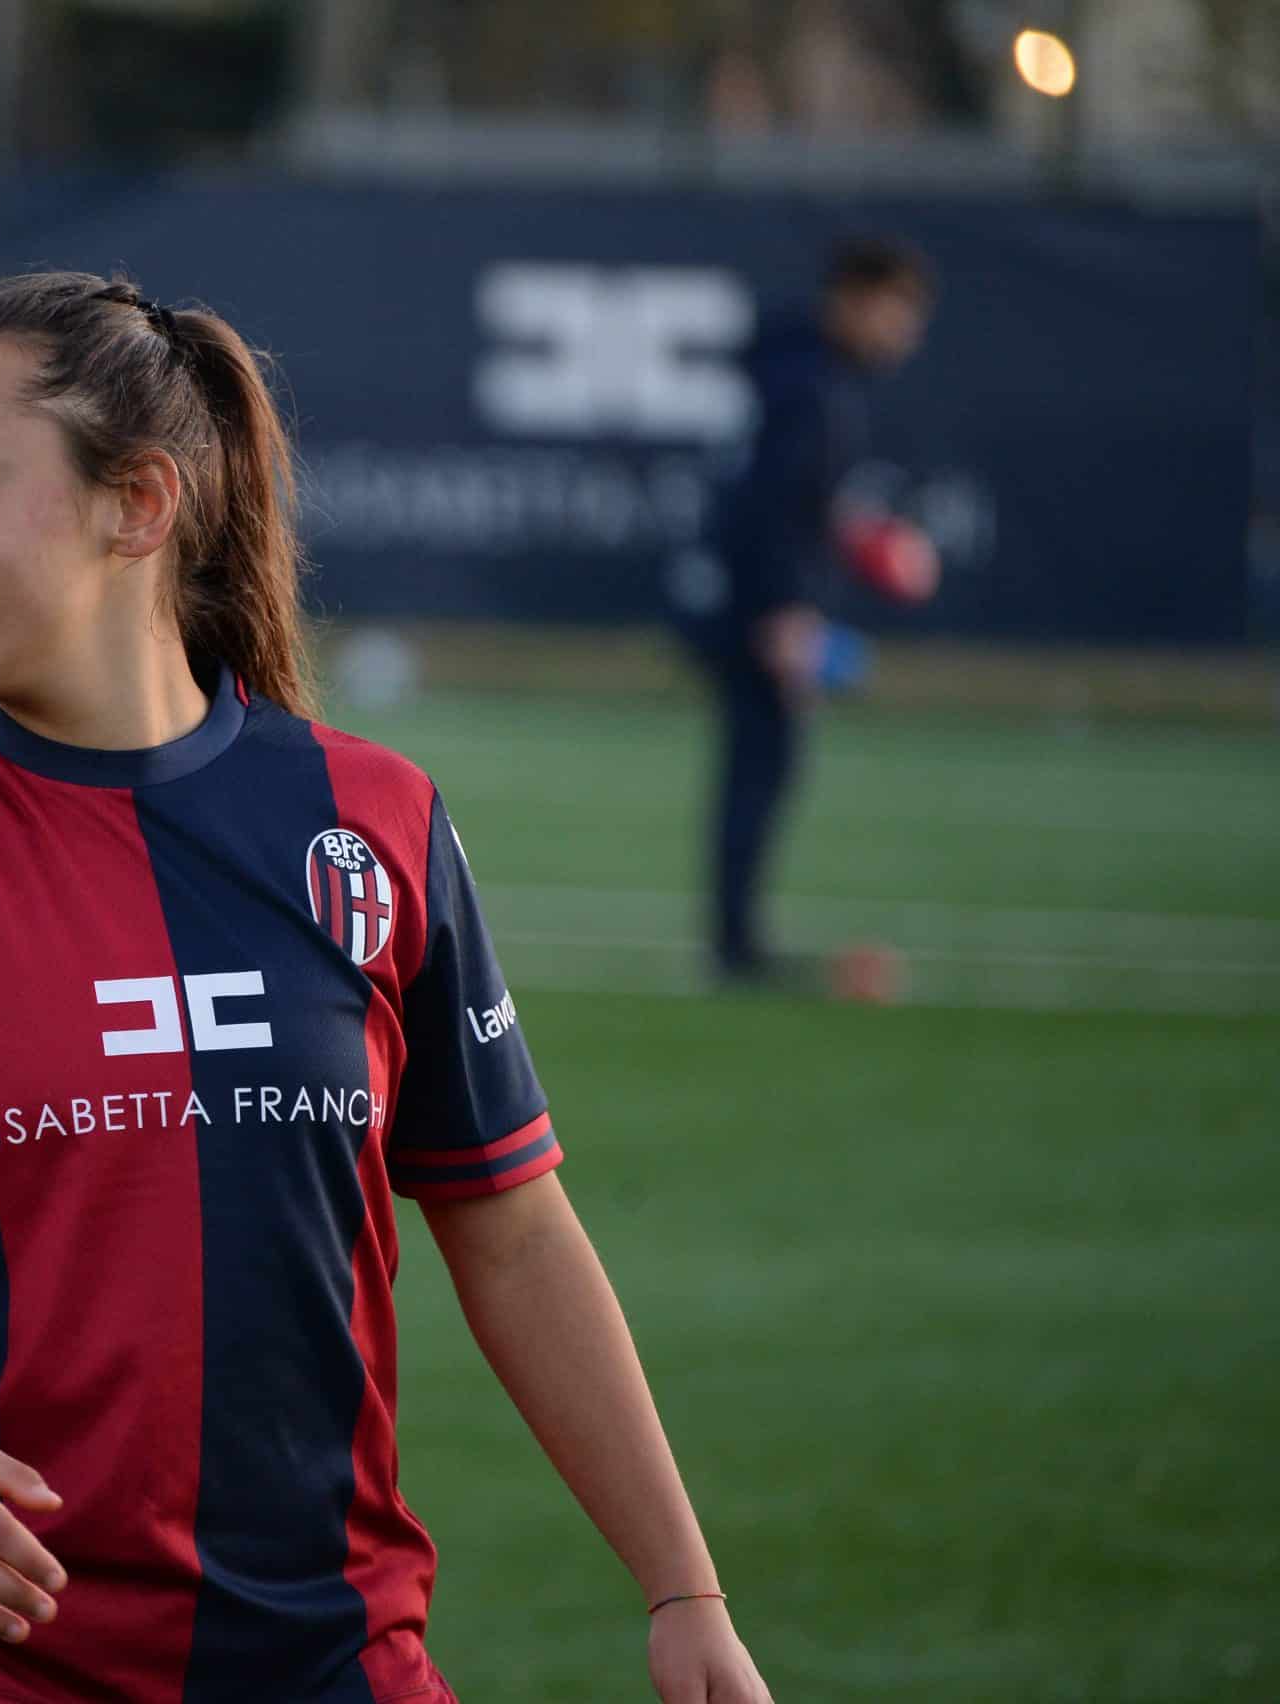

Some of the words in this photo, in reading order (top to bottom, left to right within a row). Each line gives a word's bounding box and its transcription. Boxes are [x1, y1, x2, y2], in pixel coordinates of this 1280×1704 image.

[322, 833, 367, 862] BFC
[333, 857, 361, 871] 1909
[233, 1086, 387, 1129] FRANCHI
